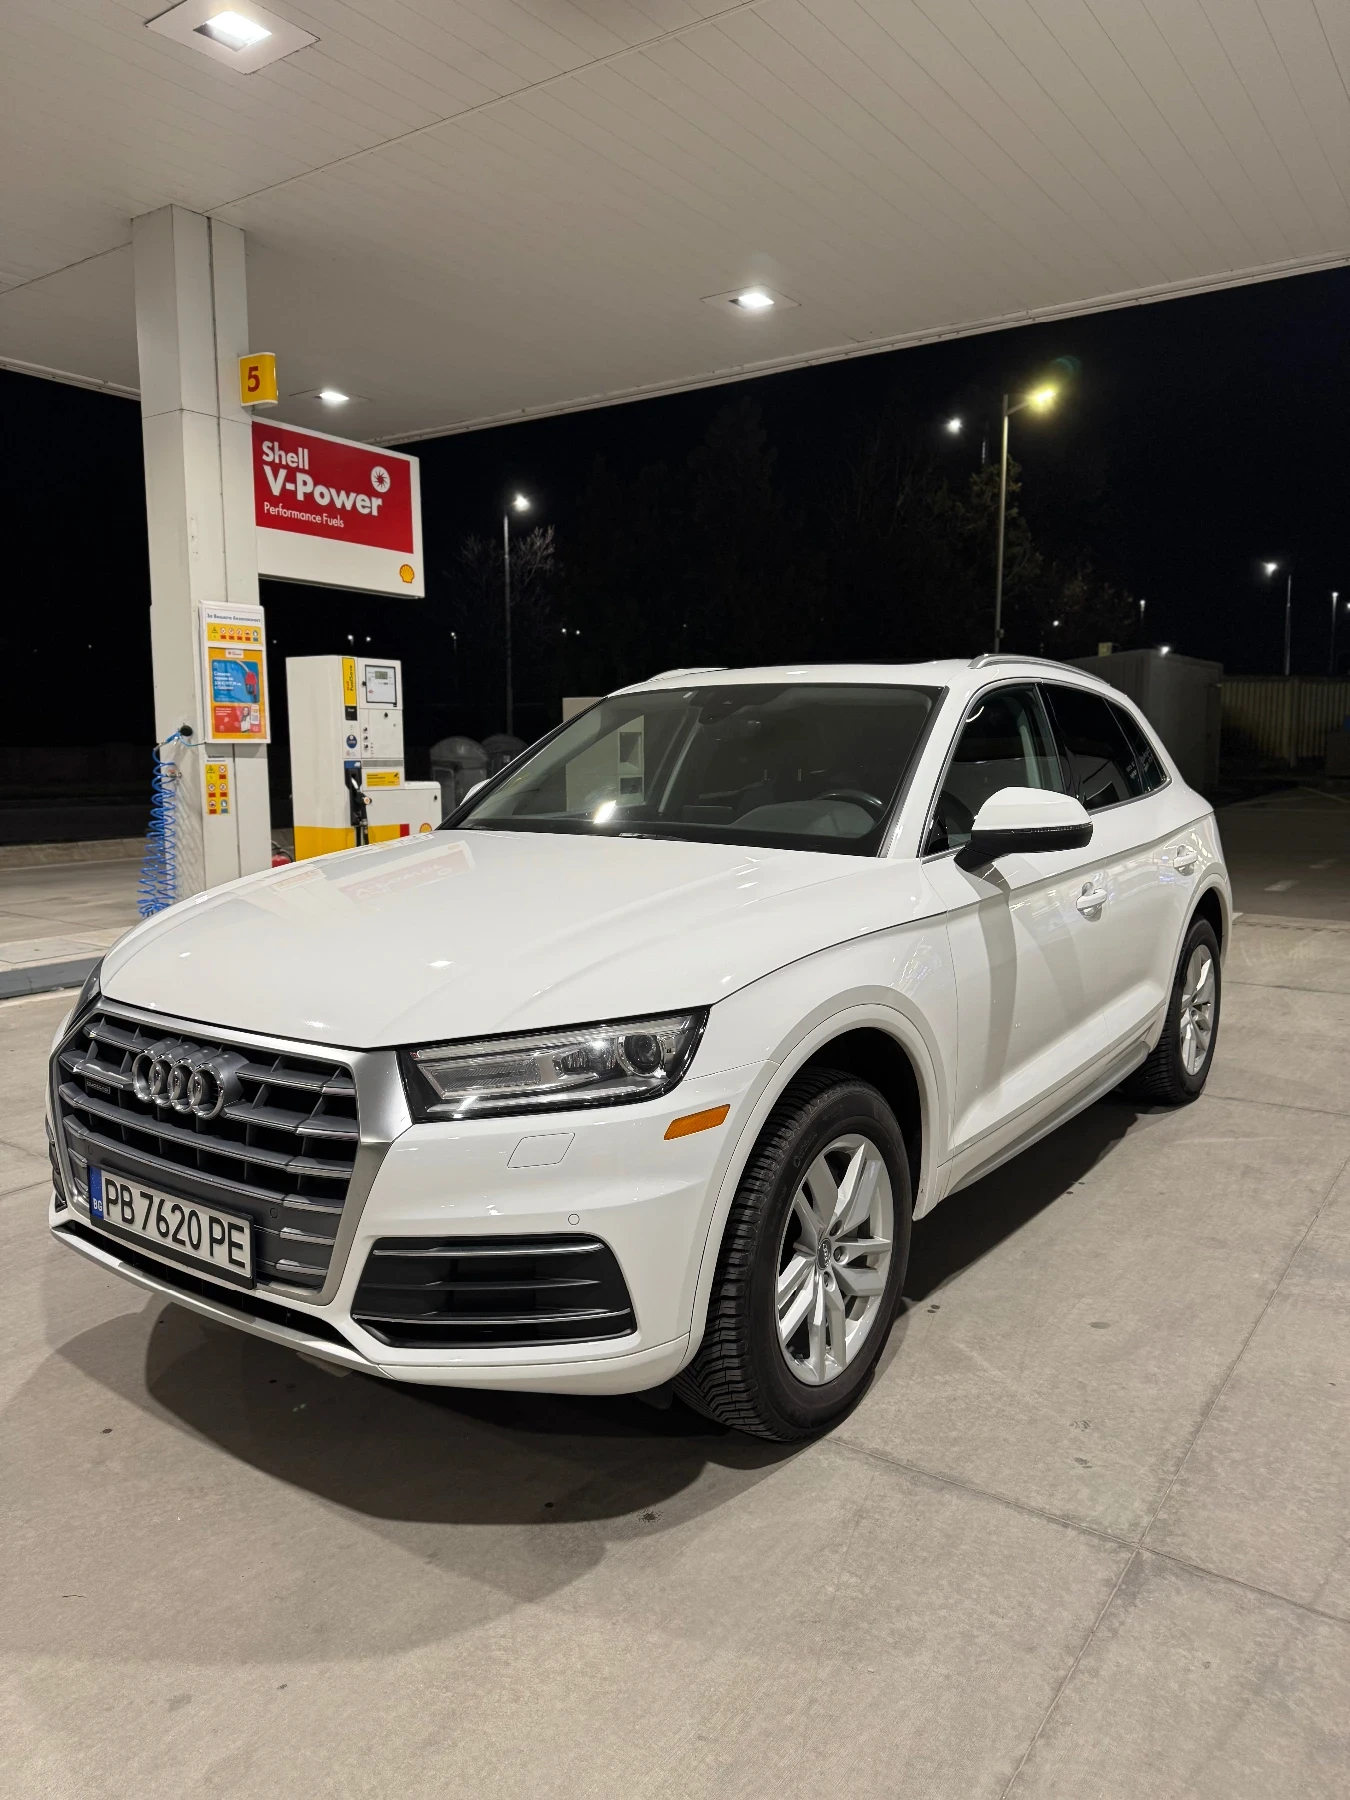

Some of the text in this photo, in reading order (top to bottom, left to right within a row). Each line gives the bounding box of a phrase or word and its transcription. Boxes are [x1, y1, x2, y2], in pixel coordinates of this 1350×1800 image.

[247, 365, 261, 393] 5
[262, 440, 309, 470] Shell
[263, 464, 383, 516] V-Power
[264, 502, 344, 528] Performance Fuels
[93, 1198, 103, 1212] BG
[104, 1177, 246, 1269] PB 7620 PE
